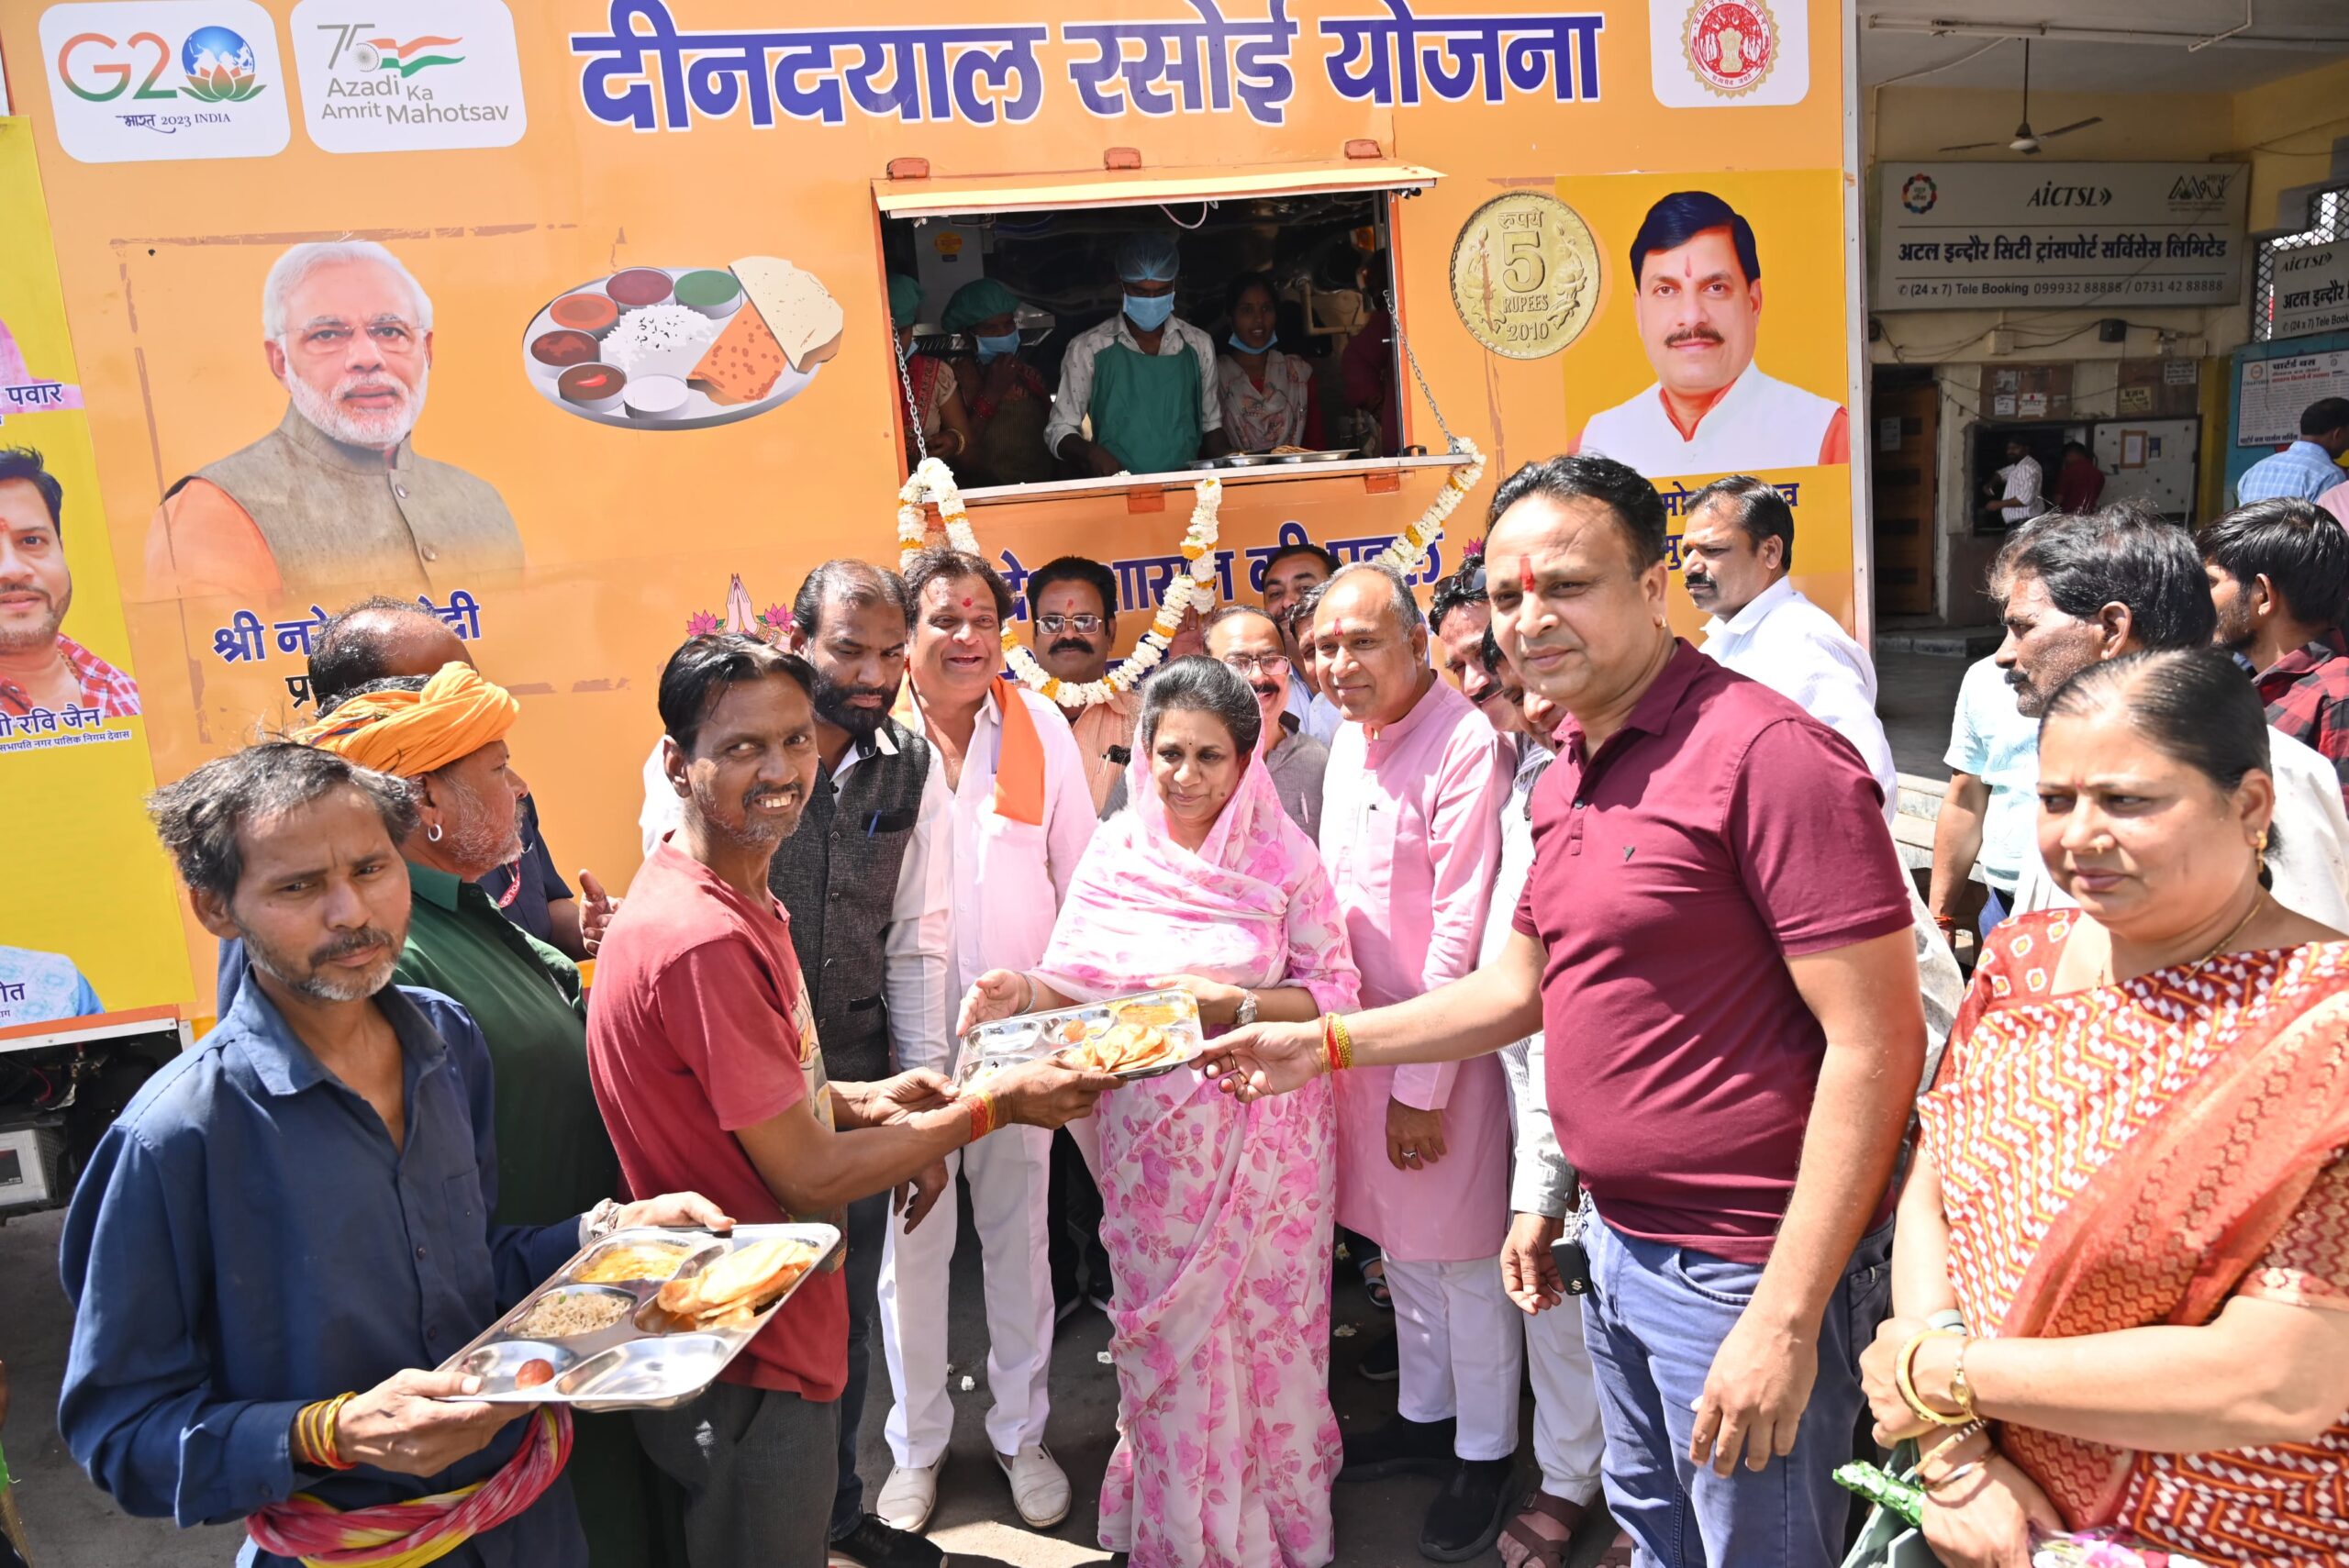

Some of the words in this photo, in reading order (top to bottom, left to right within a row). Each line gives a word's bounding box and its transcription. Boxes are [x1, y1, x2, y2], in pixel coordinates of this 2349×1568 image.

[571, 0, 1047, 129] दीनदयाल
[1064, 0, 1298, 123] रसोई
[1319, 0, 1603, 105] योजना
[327, 75, 401, 99] Azadi
[406, 84, 434, 102] Ka
[161, 116, 192, 128] 2023
[195, 113, 231, 124] INDIA
[321, 102, 383, 120] Amrit
[386, 102, 509, 126] Mahotsav
[1898, 242, 1941, 261] अटल
[1944, 235, 1990, 263] इन्दौर
[1994, 235, 2032, 261] सिटी
[2036, 233, 2099, 263] ट्रांसपोर्ट
[2101, 233, 2162, 259] सर्विसेस
[2165, 232, 2228, 258] लिमिटेड
[1502, 230, 1546, 293] 5
[1910, 284, 1928, 297] (24
[1942, 284, 1953, 297] 7)
[1956, 283, 1978, 295] Tele
[1982, 283, 2029, 295] Booking
[2033, 282, 2080, 295] 099932
[2134, 281, 2164, 293] 0731
[2167, 281, 2182, 292] 42
[2186, 280, 2223, 292] 88888
[1503, 294, 1549, 314] RUPEES
[1506, 322, 1550, 342] 2010
[2316, 316, 2331, 327] Tele
[5, 384, 62, 405] पवार
[214, 610, 265, 662] श्री
[17, 707, 56, 734] रवि
[60, 703, 100, 728] जैन
[34, 738, 52, 748] नगर
[83, 732, 106, 743] निगम
[108, 729, 130, 740] देवास
